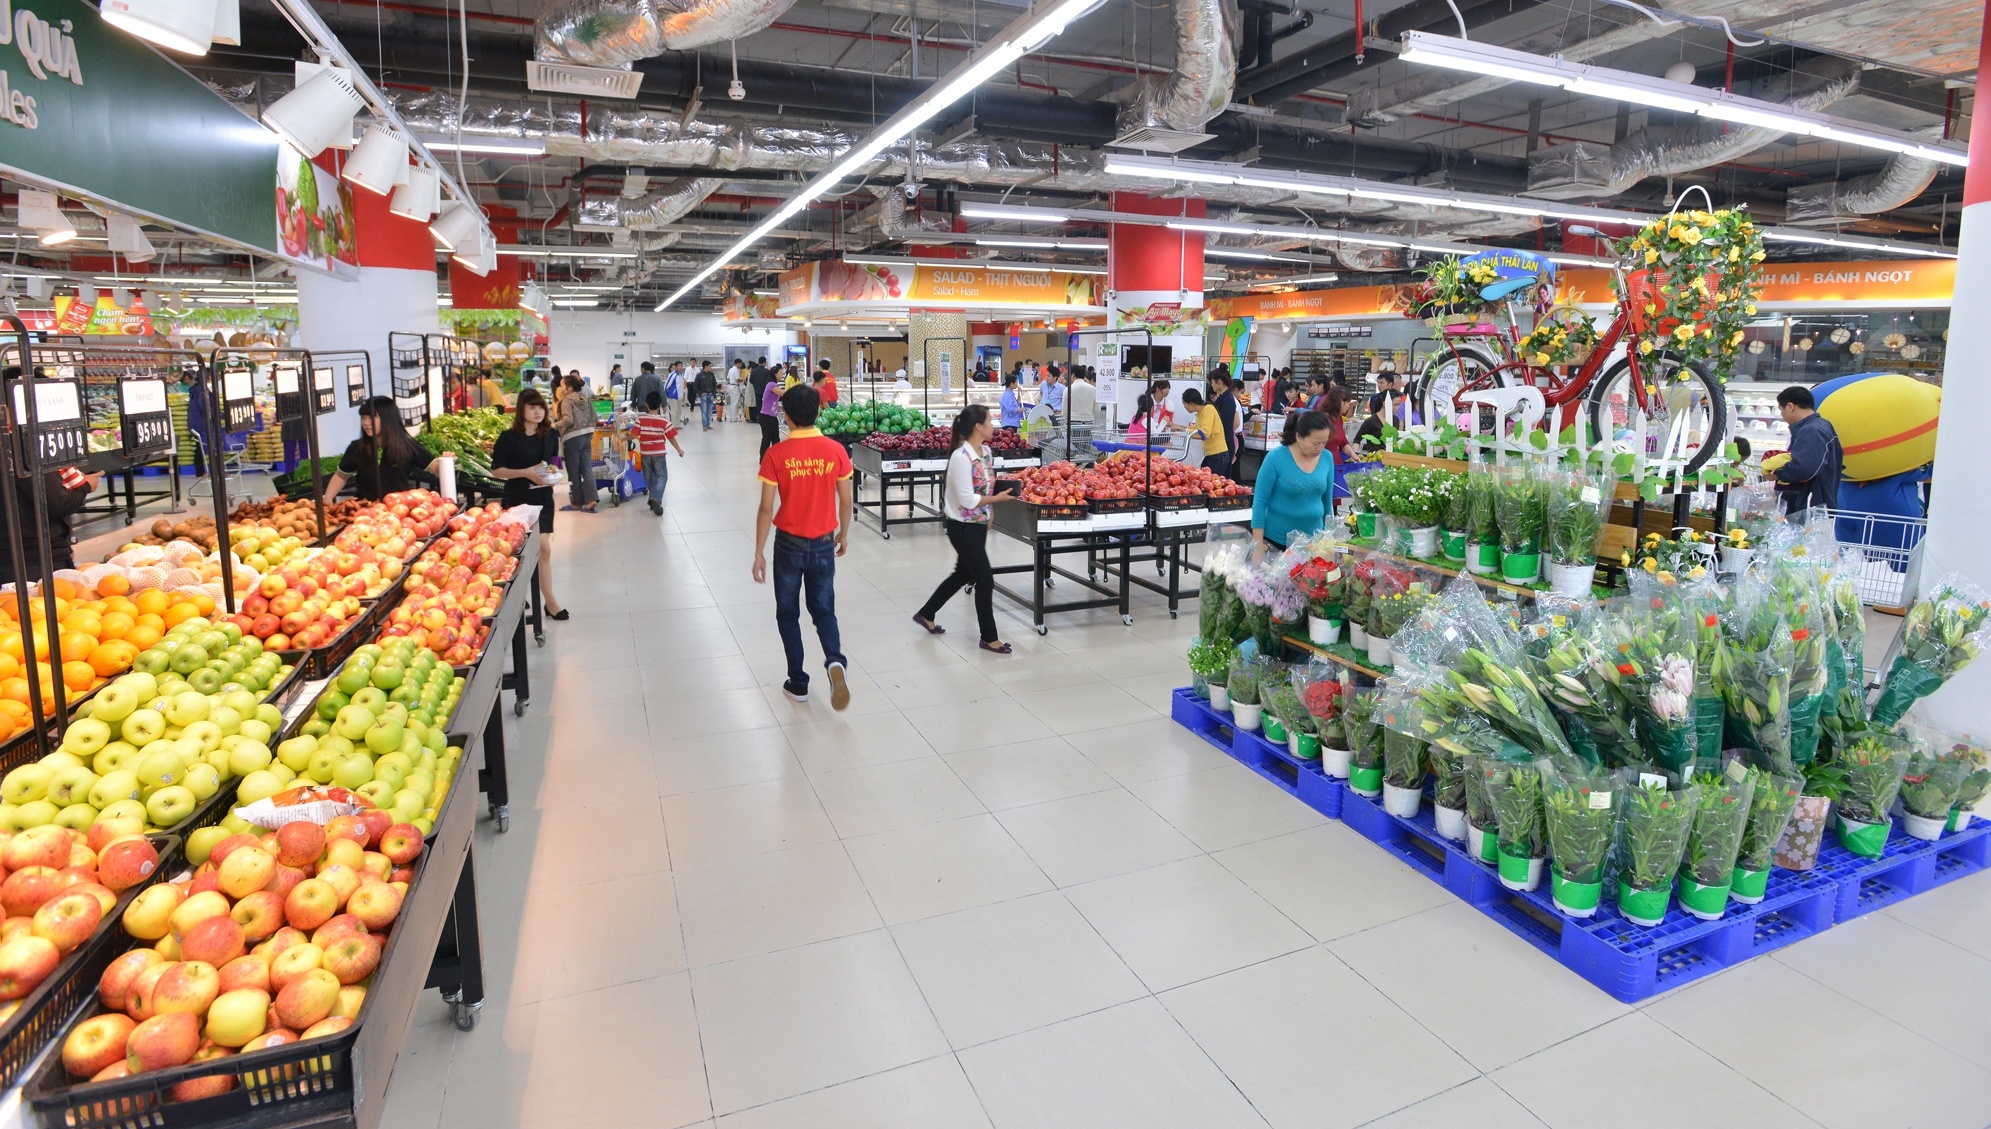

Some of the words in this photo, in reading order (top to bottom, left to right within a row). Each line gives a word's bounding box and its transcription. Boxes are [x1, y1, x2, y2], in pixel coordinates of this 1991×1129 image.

[14, 8, 84, 86] QUẢ
[1501, 254, 1520, 269] THÁI
[1521, 259, 1539, 272] LAN
[933, 270, 975, 284] SALAD
[984, 272, 1010, 289] THỊT
[1013, 271, 1051, 290] NGUỘI
[1780, 271, 1799, 285] MÌ
[1813, 270, 1860, 284] BÁNH
[1864, 270, 1912, 285] NGỌT
[933, 286, 954, 296] Salad
[961, 286, 979, 296] Ham
[1260, 299, 1275, 309] BÁNH
[1276, 298, 1284, 309] MÌ
[1288, 298, 1304, 308] BÁNH
[1306, 297, 1323, 308] NGỌT
[803, 457, 825, 469] sàng
[790, 467, 812, 480] phục
